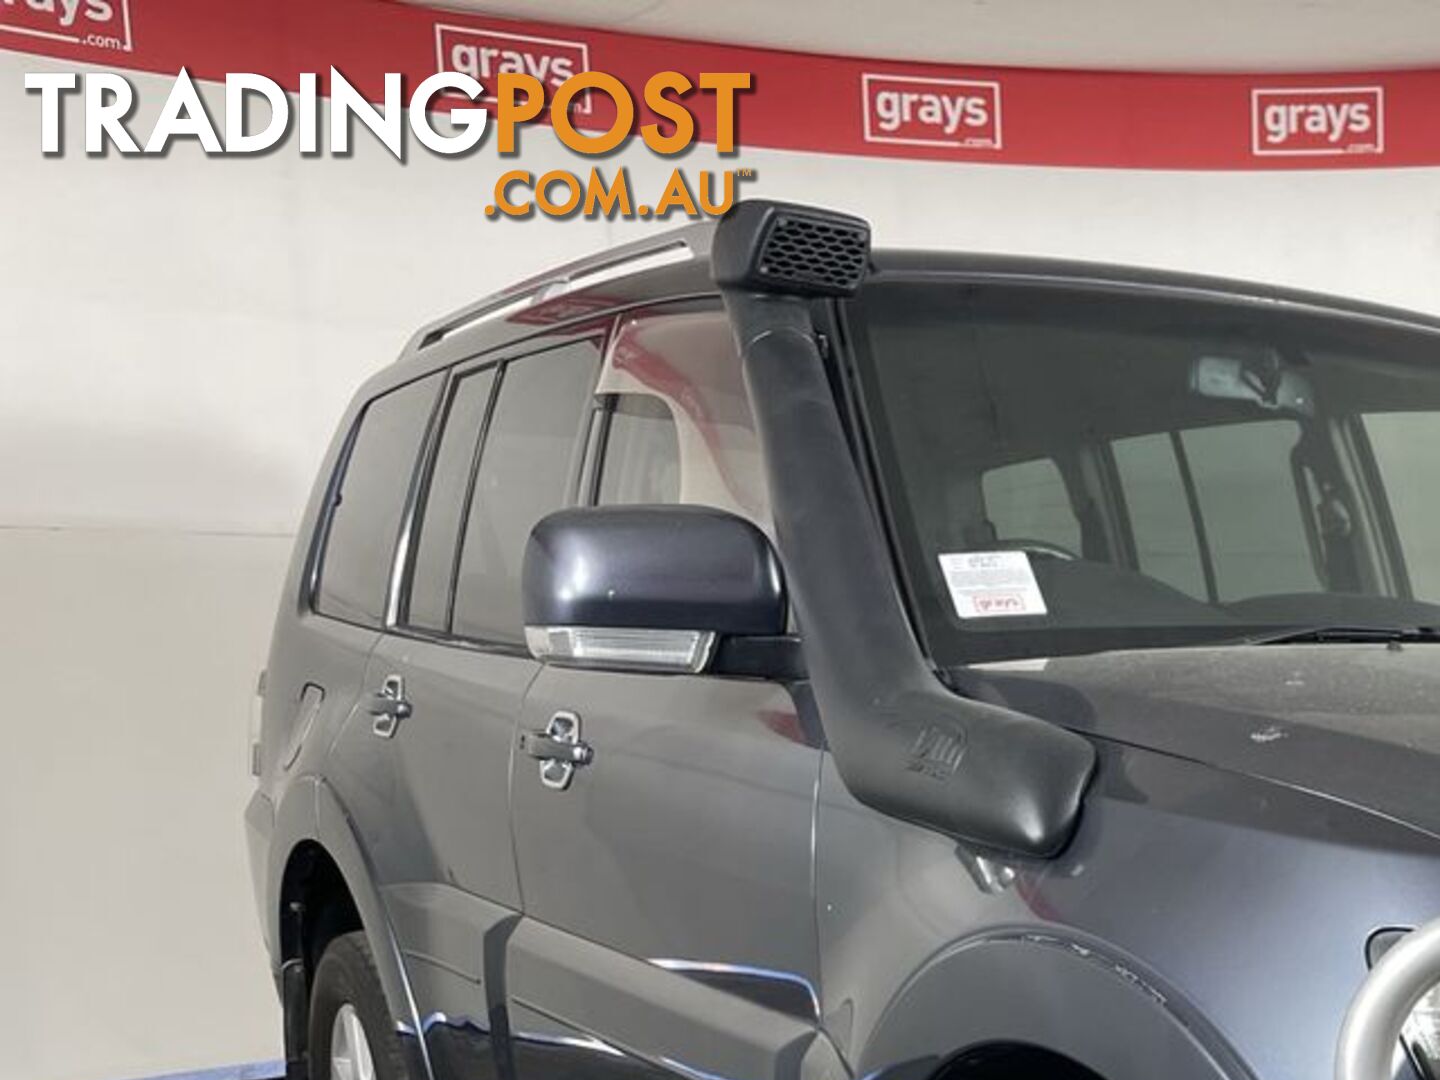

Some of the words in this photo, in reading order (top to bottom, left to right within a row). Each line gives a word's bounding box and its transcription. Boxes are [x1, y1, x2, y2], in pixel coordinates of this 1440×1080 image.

[82, 34, 120, 49] .com
[452, 44, 574, 88] grays
[876, 91, 988, 134] grays
[1264, 102, 1371, 143] grays
